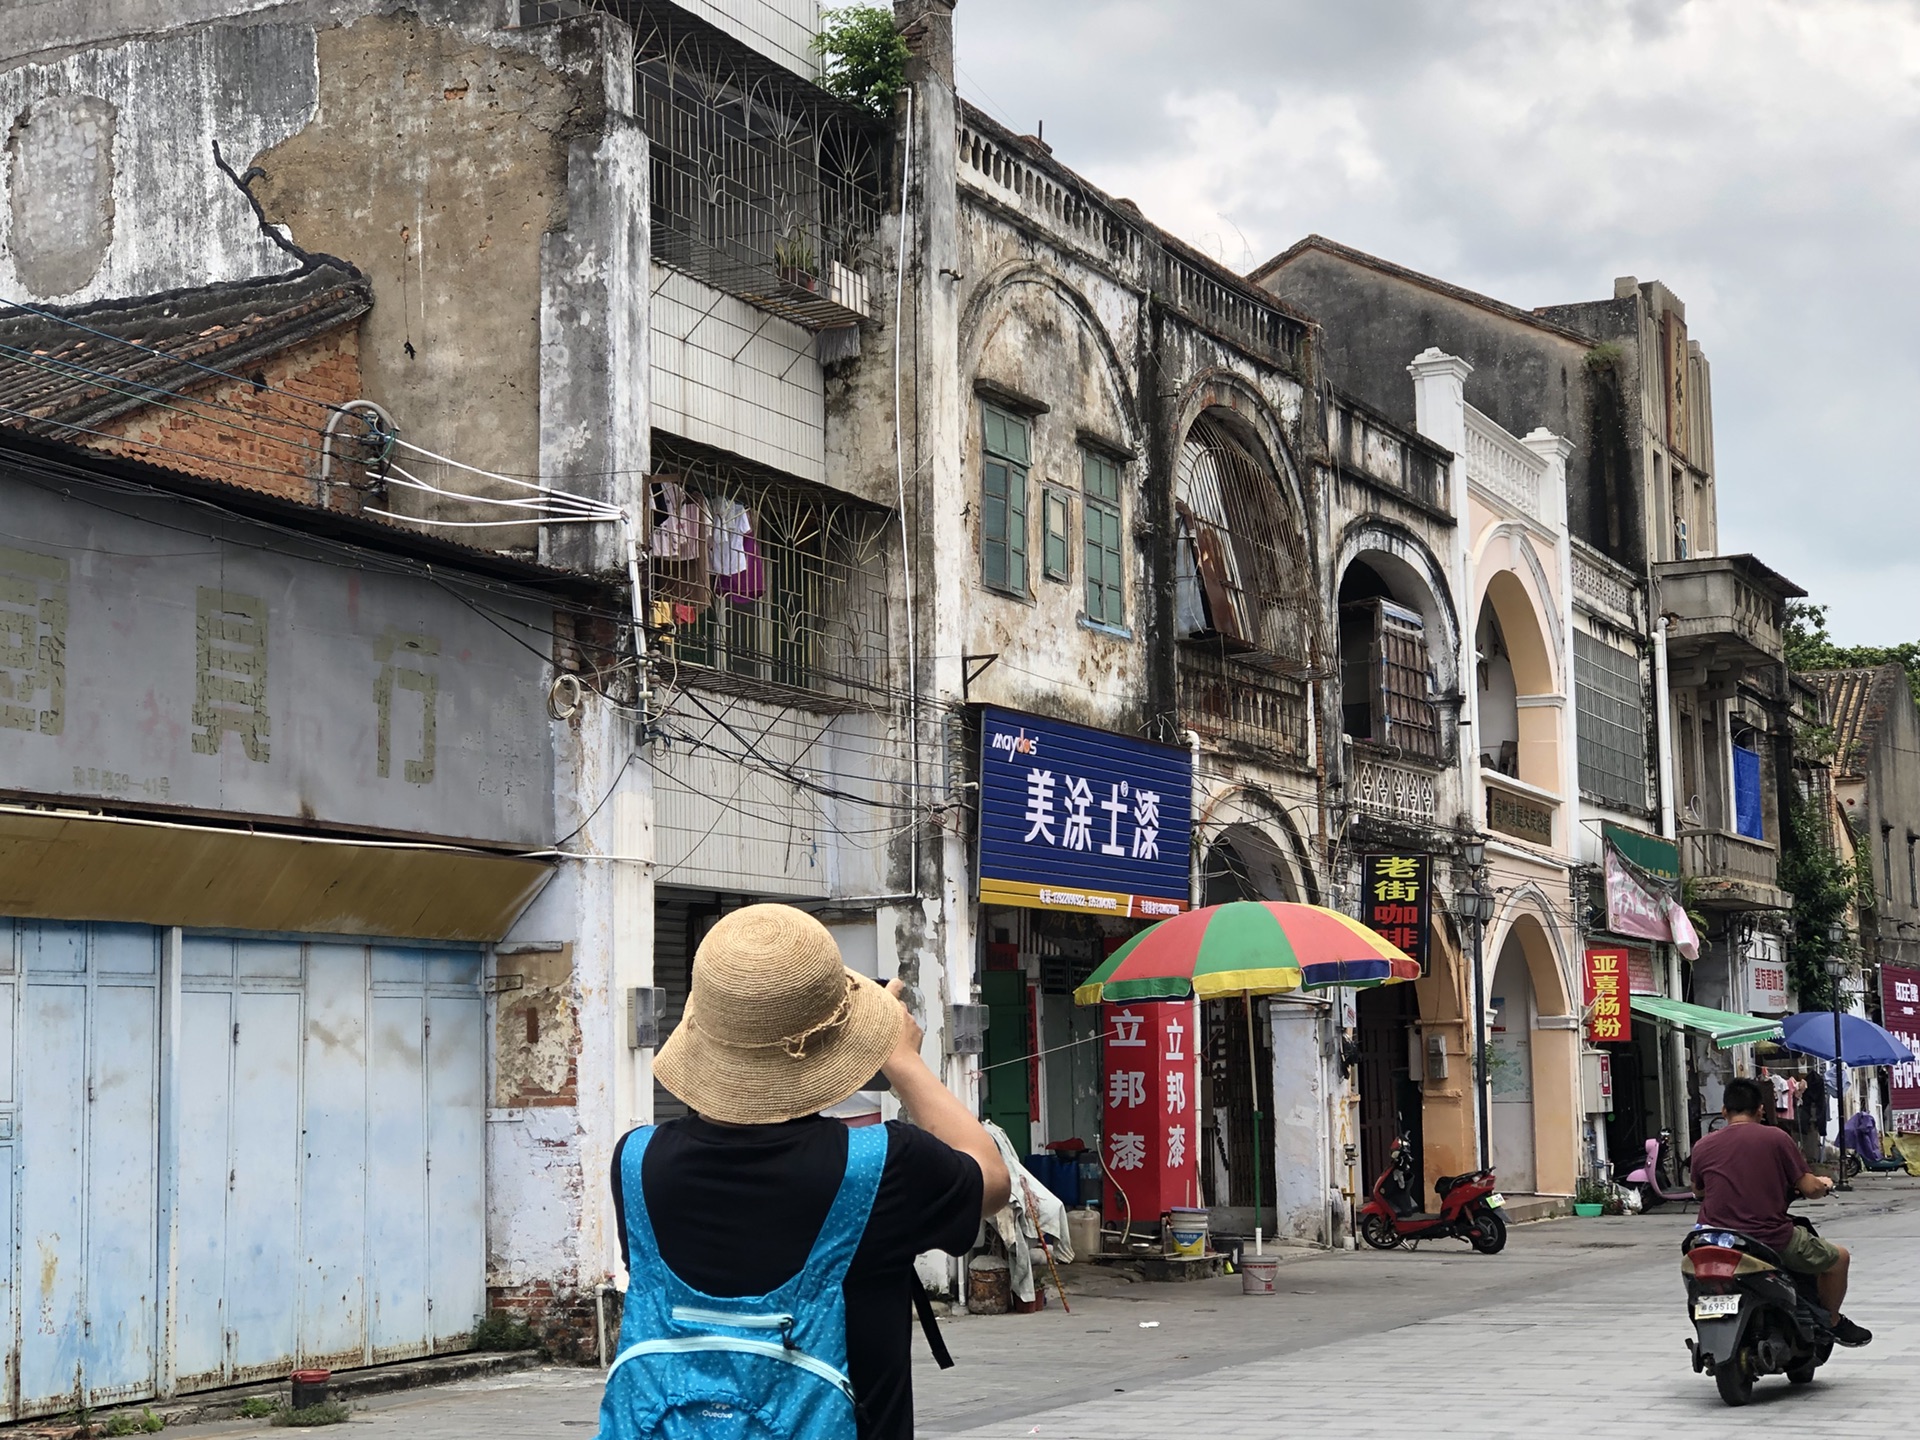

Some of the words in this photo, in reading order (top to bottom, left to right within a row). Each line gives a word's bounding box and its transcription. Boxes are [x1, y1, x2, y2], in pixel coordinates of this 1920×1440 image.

[992, 728, 1038, 762] maydos
[1024, 768, 1160, 860] 美涂士漆
[1374, 857, 1420, 960] 老街咖啡
[1592, 955, 1621, 1038] 亚喜肠粉
[1109, 1009, 1146, 1171] 立邦漆
[1166, 1001, 1186, 1168] 立邦漆
